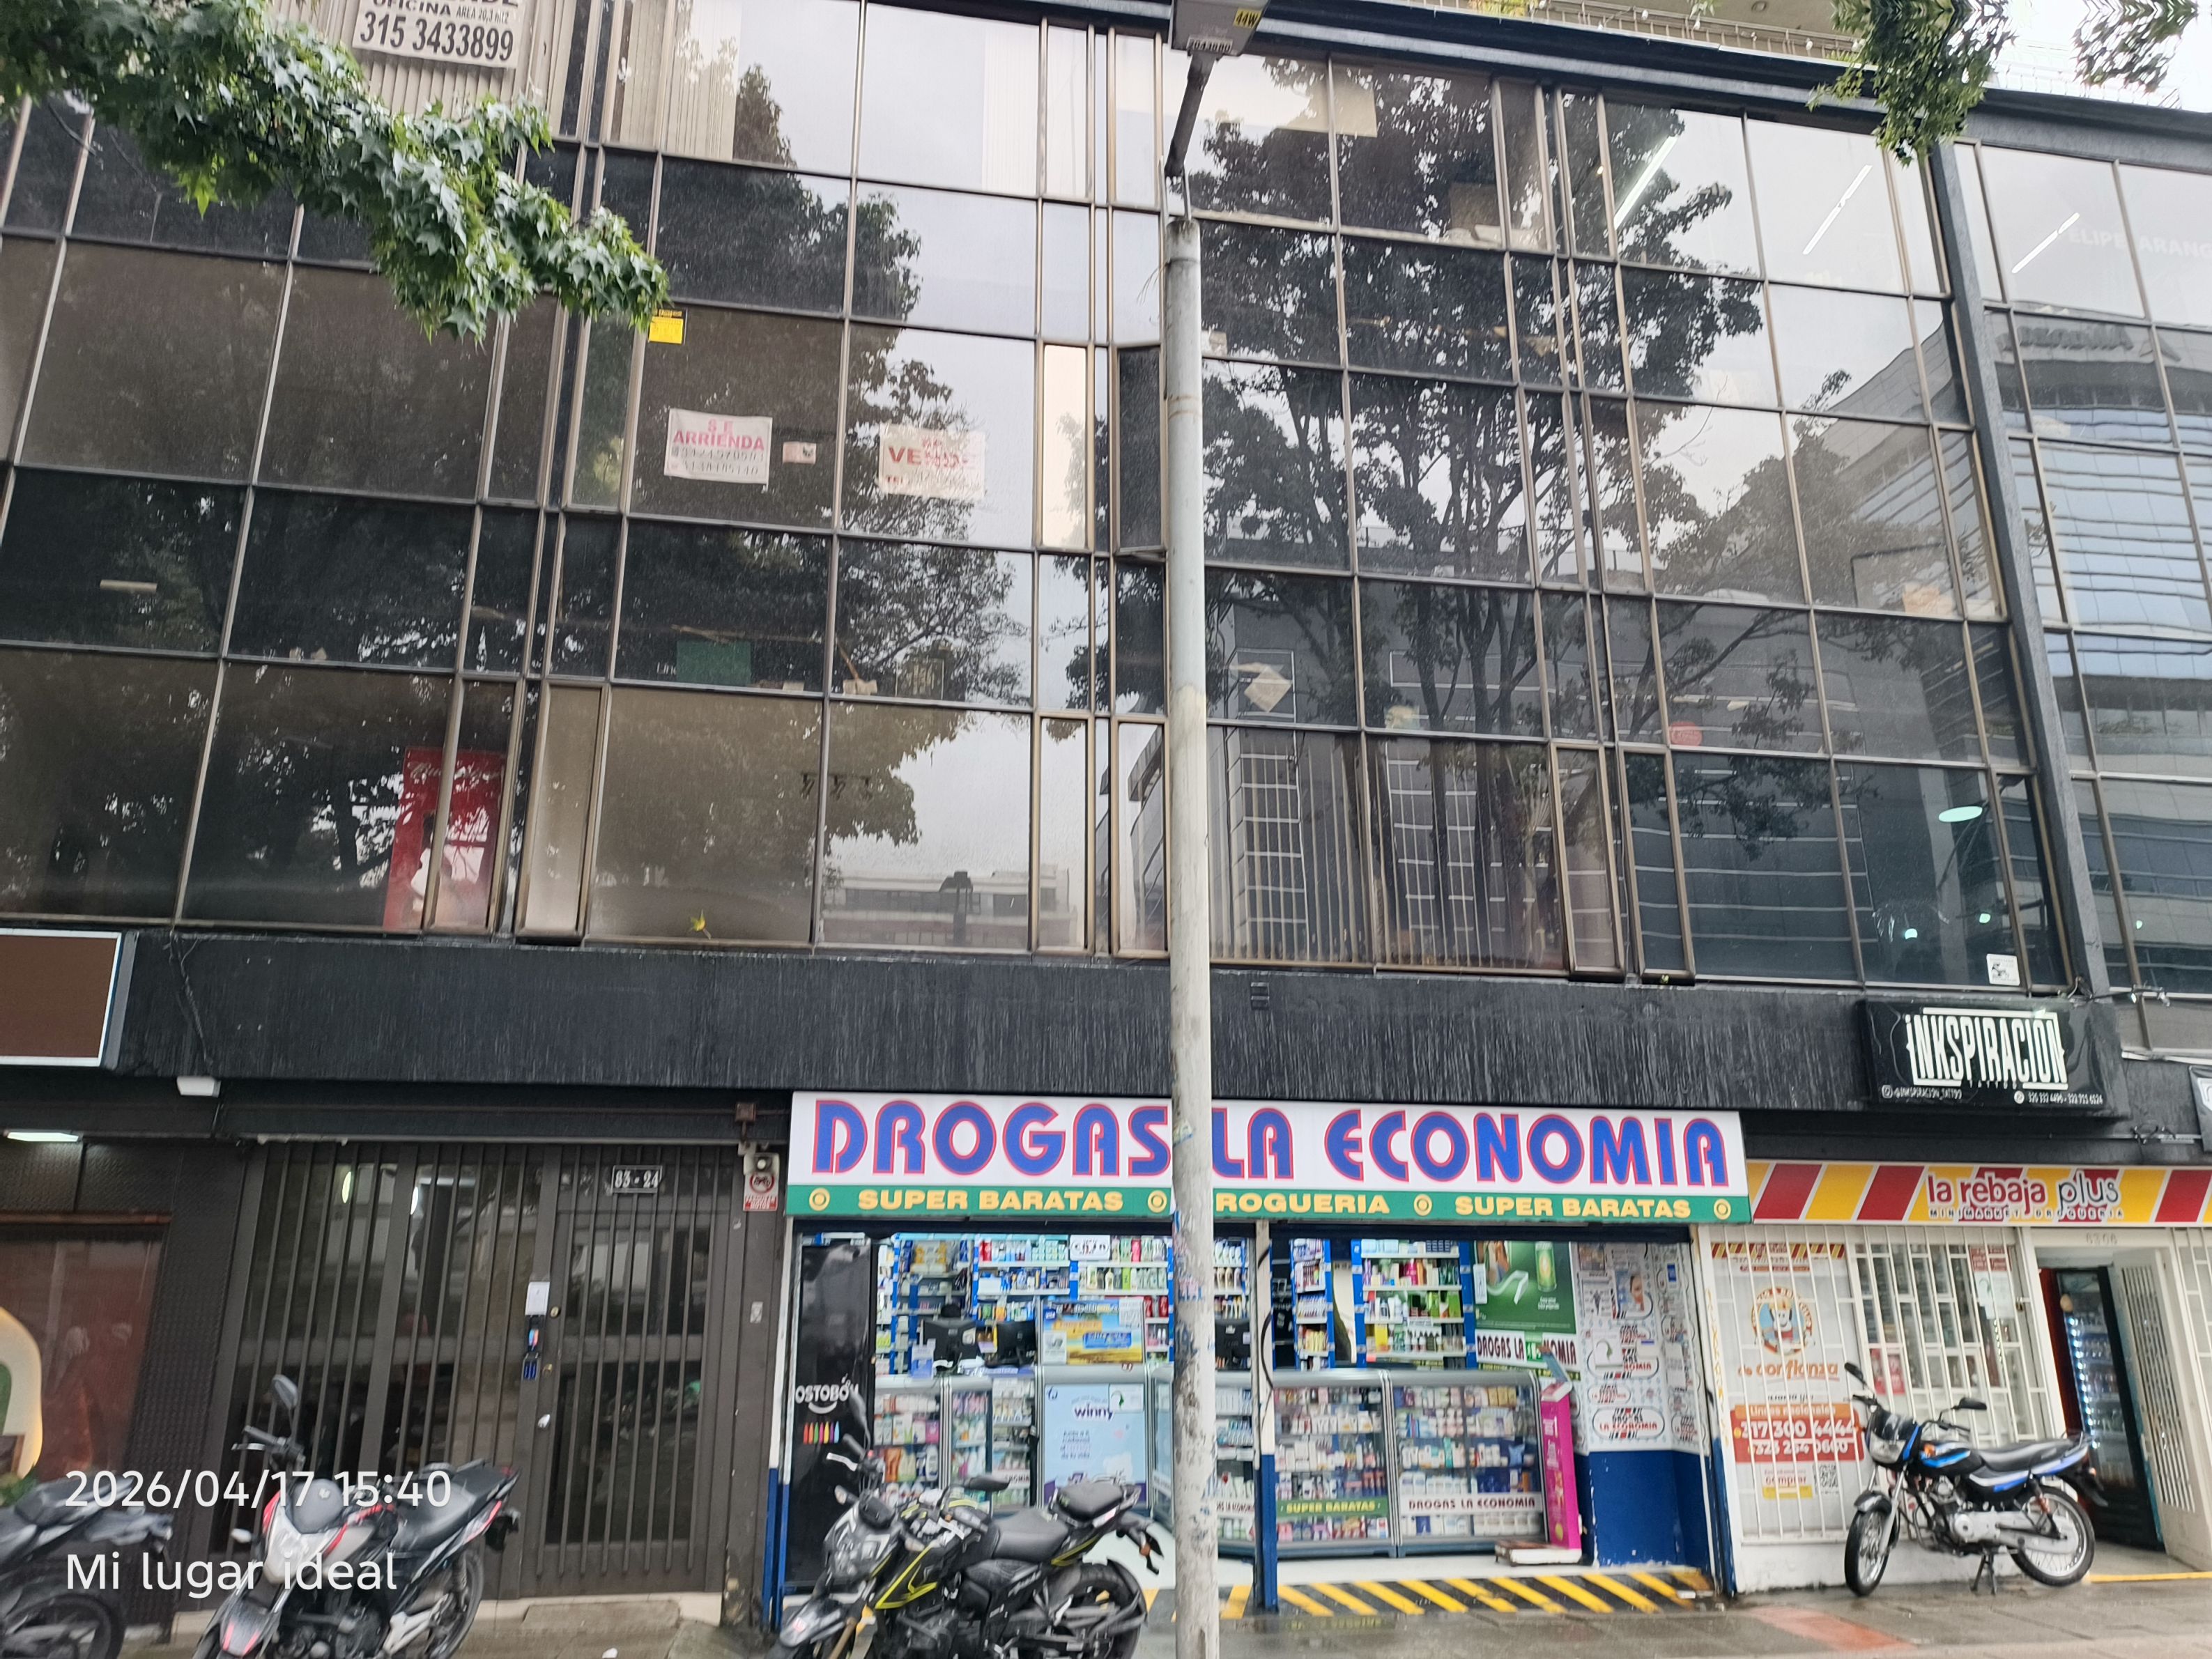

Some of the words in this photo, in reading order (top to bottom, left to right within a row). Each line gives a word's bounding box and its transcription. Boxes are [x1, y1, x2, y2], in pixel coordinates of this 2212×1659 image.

[456, 6, 476, 20] AREA
[1236, 10, 1259, 29] 44W
[360, 11, 406, 48] 315
[412, 18, 514, 61] 3433899
[673, 429, 765, 451] ARRIENDA
[811, 1099, 1171, 1176] DROGAS
[1212, 1106, 1294, 1180] LA
[1323, 1109, 1730, 1188] ECONOMIA
[857, 1189, 969, 1211] SUPER
[978, 1190, 1124, 1212] BARATAS
[1215, 1192, 1390, 1215] ROGUERIA
[1928, 1175, 1952, 1203] la
[1960, 1174, 2046, 1215] rebaja
[2058, 1173, 2119, 1214] plus
[1454, 1196, 1546, 1217] SUPER
[1562, 1198, 1691, 1219] BARATAS
[1929, 1209, 2020, 1218] MINIMARKET
[2035, 1209, 2123, 1219] DROGUERIA
[1477, 1335, 1512, 1359] DROGAS
[1514, 1337, 1525, 1361] LA
[1075, 1404, 1113, 1421] winny
[1287, 1502, 1322, 1514] SUPER
[1326, 1500, 1376, 1513] BARATAS
[1408, 1499, 1456, 1510] DROGAS
[1461, 1499, 1474, 1509] LA
[1477, 1498, 1536, 1508] ECONOMIA
